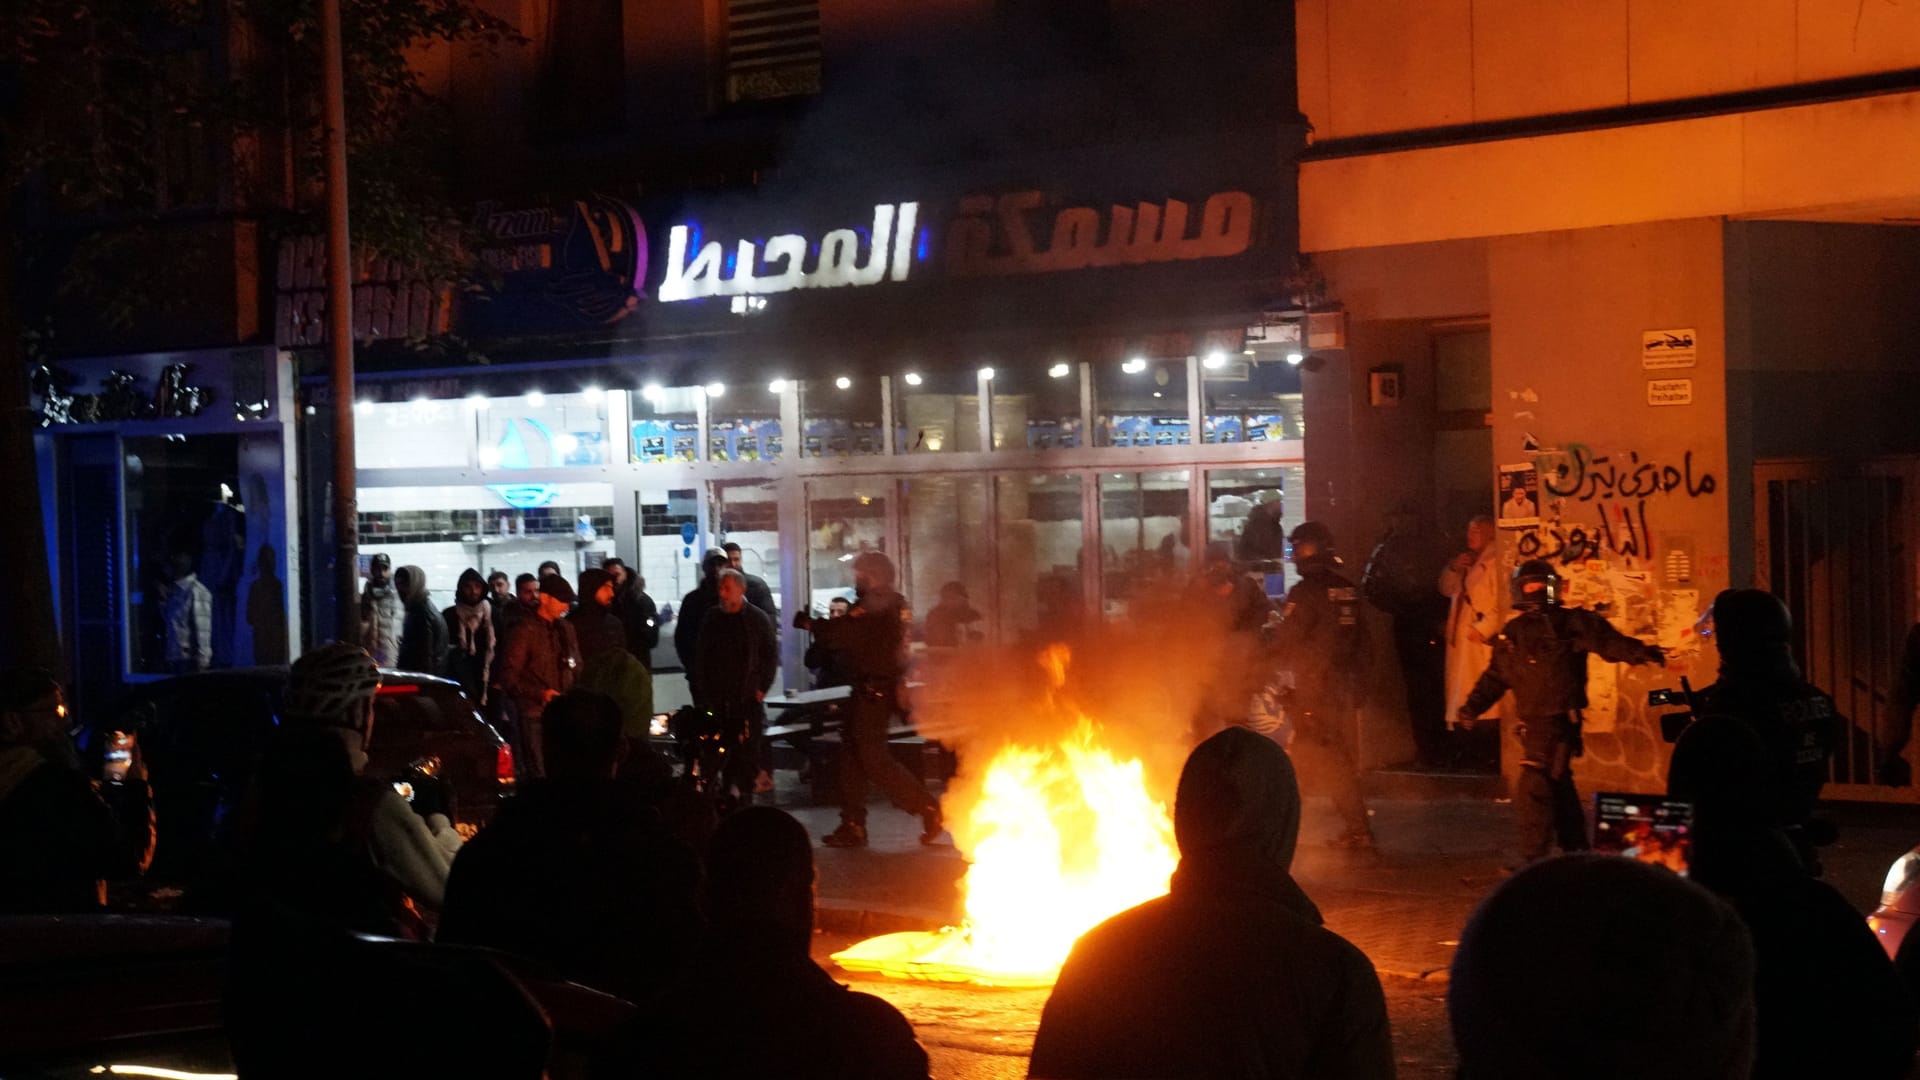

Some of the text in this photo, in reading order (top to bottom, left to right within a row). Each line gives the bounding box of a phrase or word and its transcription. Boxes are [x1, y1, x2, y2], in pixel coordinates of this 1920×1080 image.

[658, 202, 918, 314] المحيط
[1650, 393, 1689, 402] freihalten
[1651, 382, 1688, 392] Ausfahrt
[1686, 451, 1715, 497] ما
